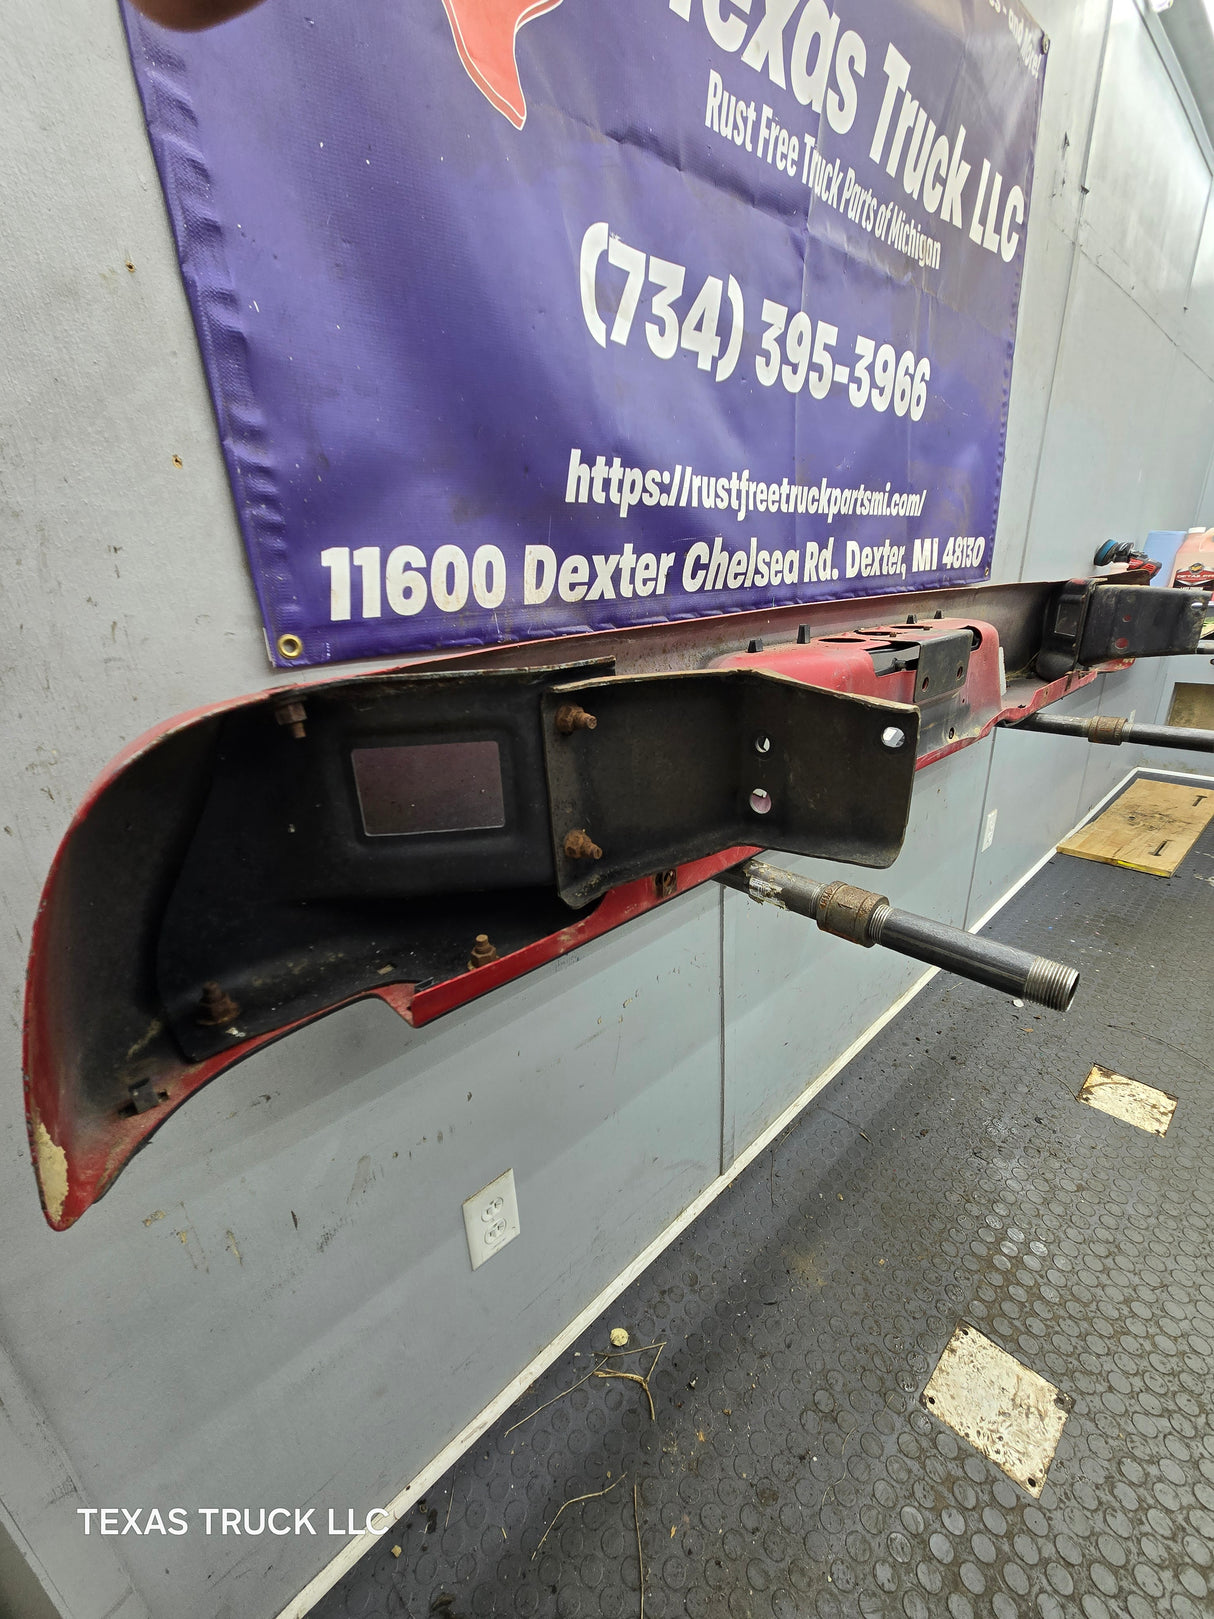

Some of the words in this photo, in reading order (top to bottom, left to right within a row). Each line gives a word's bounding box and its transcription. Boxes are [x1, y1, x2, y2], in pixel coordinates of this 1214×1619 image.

[1008, 8, 1024, 46] and
[669, 0, 867, 135] exas
[869, 42, 972, 230] Truck
[968, 157, 1025, 263] LLC
[704, 68, 757, 152] Rust
[756, 103, 800, 177] Free
[801, 132, 845, 209] Truck
[839, 166, 878, 232] Parts
[874, 201, 894, 241] of
[887, 204, 942, 270] Michigan
[579, 222, 744, 383] (734)
[755, 299, 931, 422] 395-3966
[564, 448, 928, 520] https://rustfreetruckpartsmi.com/
[320, 544, 507, 621] 11600
[523, 542, 678, 606] Dexter
[682, 535, 800, 592] Chelsea
[803, 536, 840, 583] Rd.
[845, 538, 906, 580] Dexter,
[911, 537, 939, 573] MI
[942, 536, 987, 570] 48130
